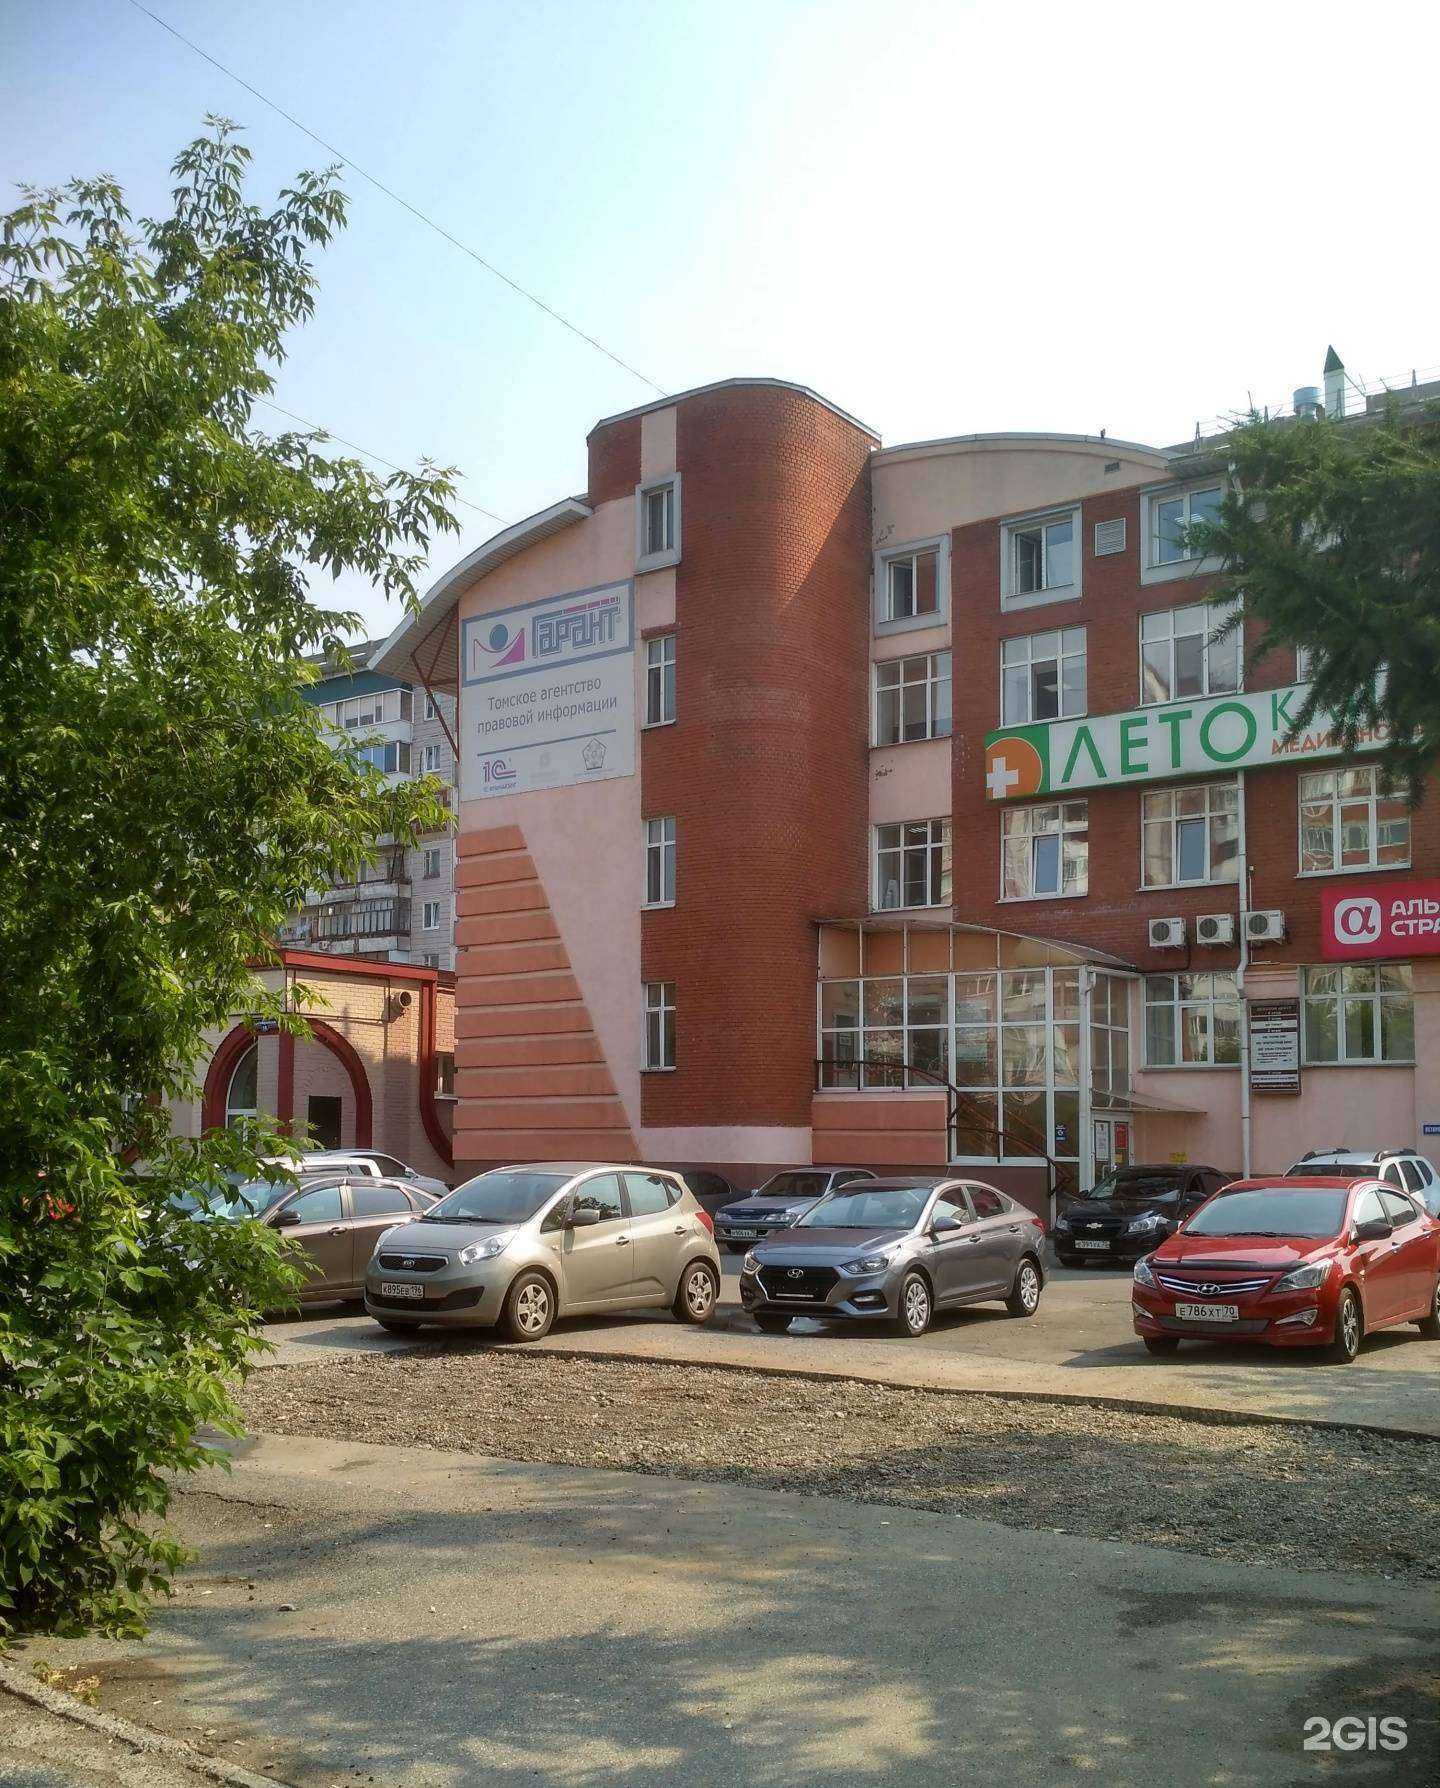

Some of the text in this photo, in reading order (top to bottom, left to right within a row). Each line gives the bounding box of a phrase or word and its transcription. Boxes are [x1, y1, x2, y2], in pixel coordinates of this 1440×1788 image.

[487, 678, 601, 711] Томское агентство
[477, 696, 617, 735] правовой информации
